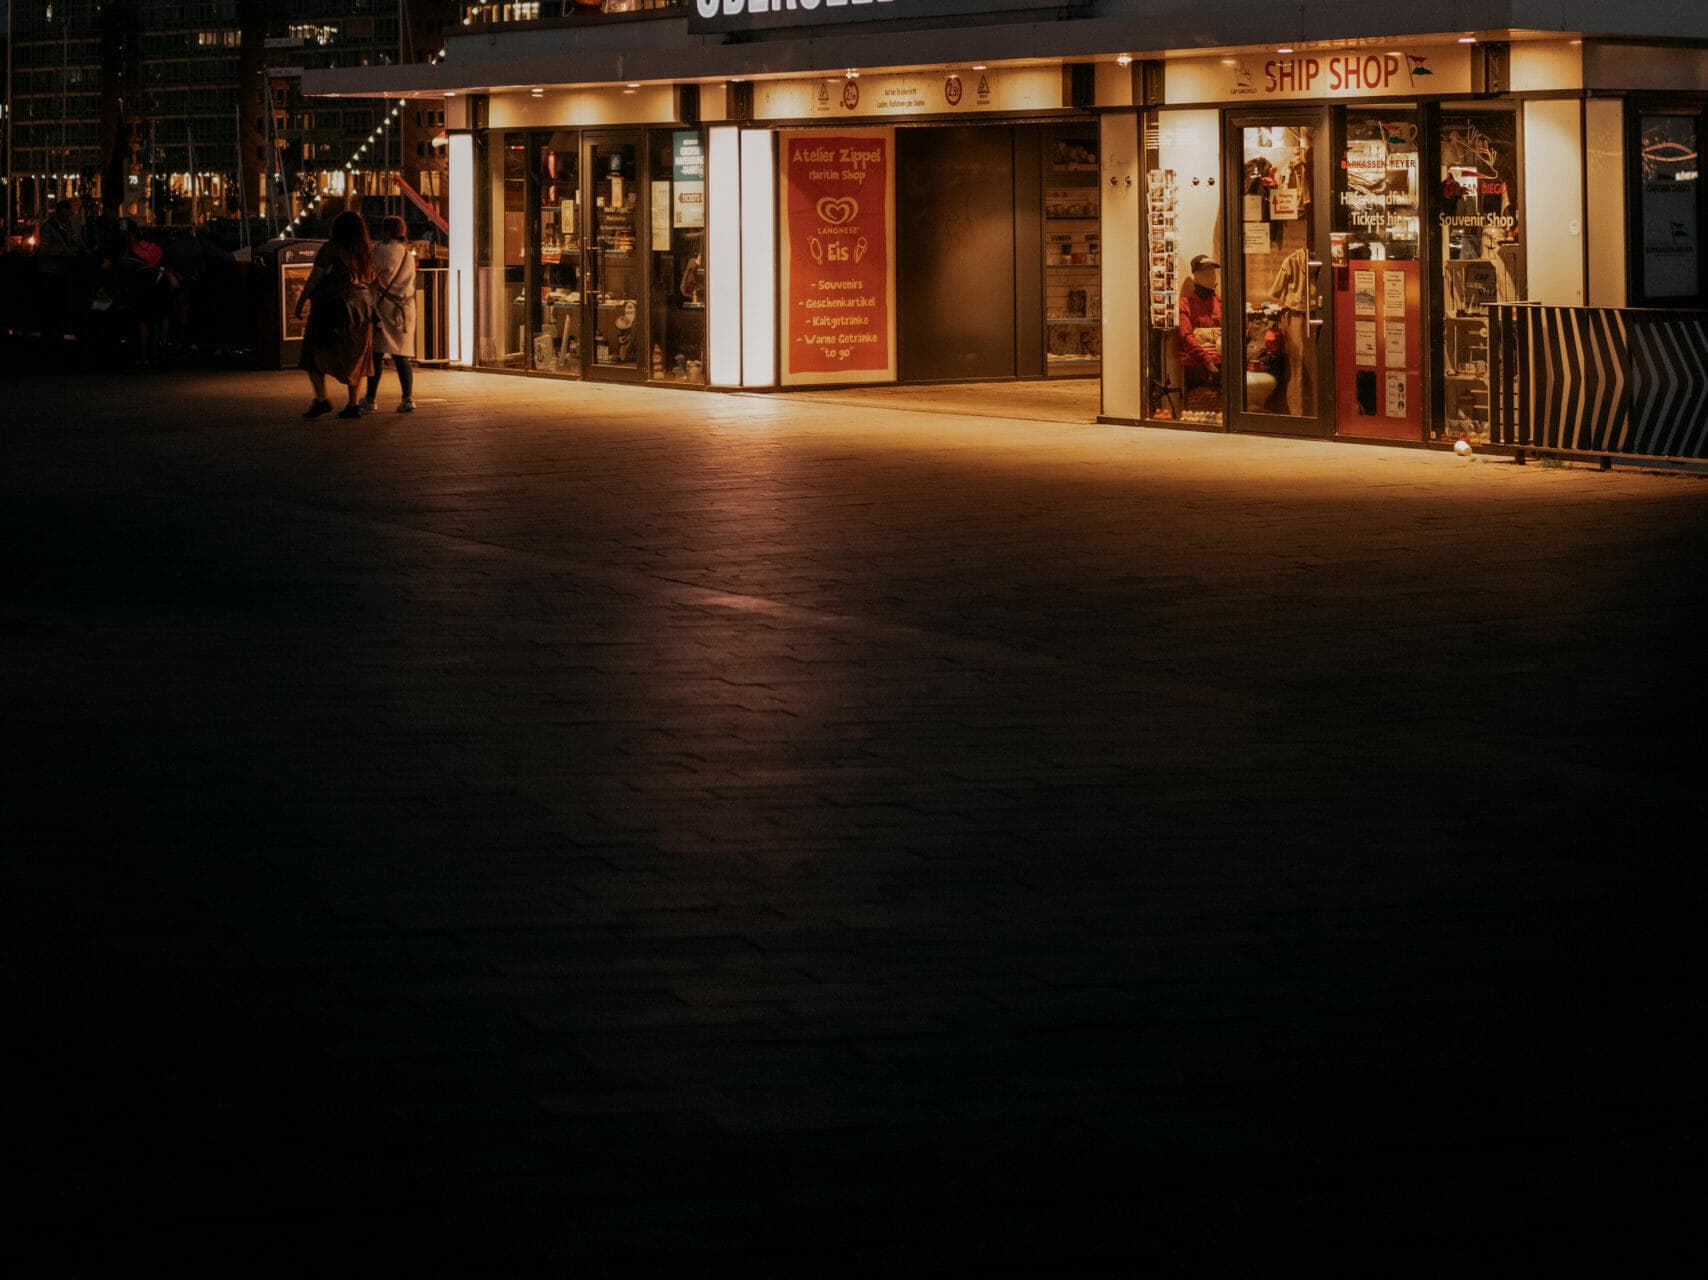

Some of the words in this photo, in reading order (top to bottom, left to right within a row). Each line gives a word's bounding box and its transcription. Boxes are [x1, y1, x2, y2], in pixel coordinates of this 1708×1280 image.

[1265, 58, 1319, 92] SHIP
[1329, 55, 1398, 90] SHOP
[793, 147, 835, 162] Atelier
[840, 147, 880, 169] Zippel
[842, 169, 866, 184] Shop
[1351, 211, 1384, 227] Tickets
[1440, 212, 1485, 226] Souvenir
[1486, 212, 1514, 231] Shop
[828, 241, 849, 261] Eis
[818, 278, 863, 289] Souvenirs
[806, 297, 875, 308] Geschenkartikel
